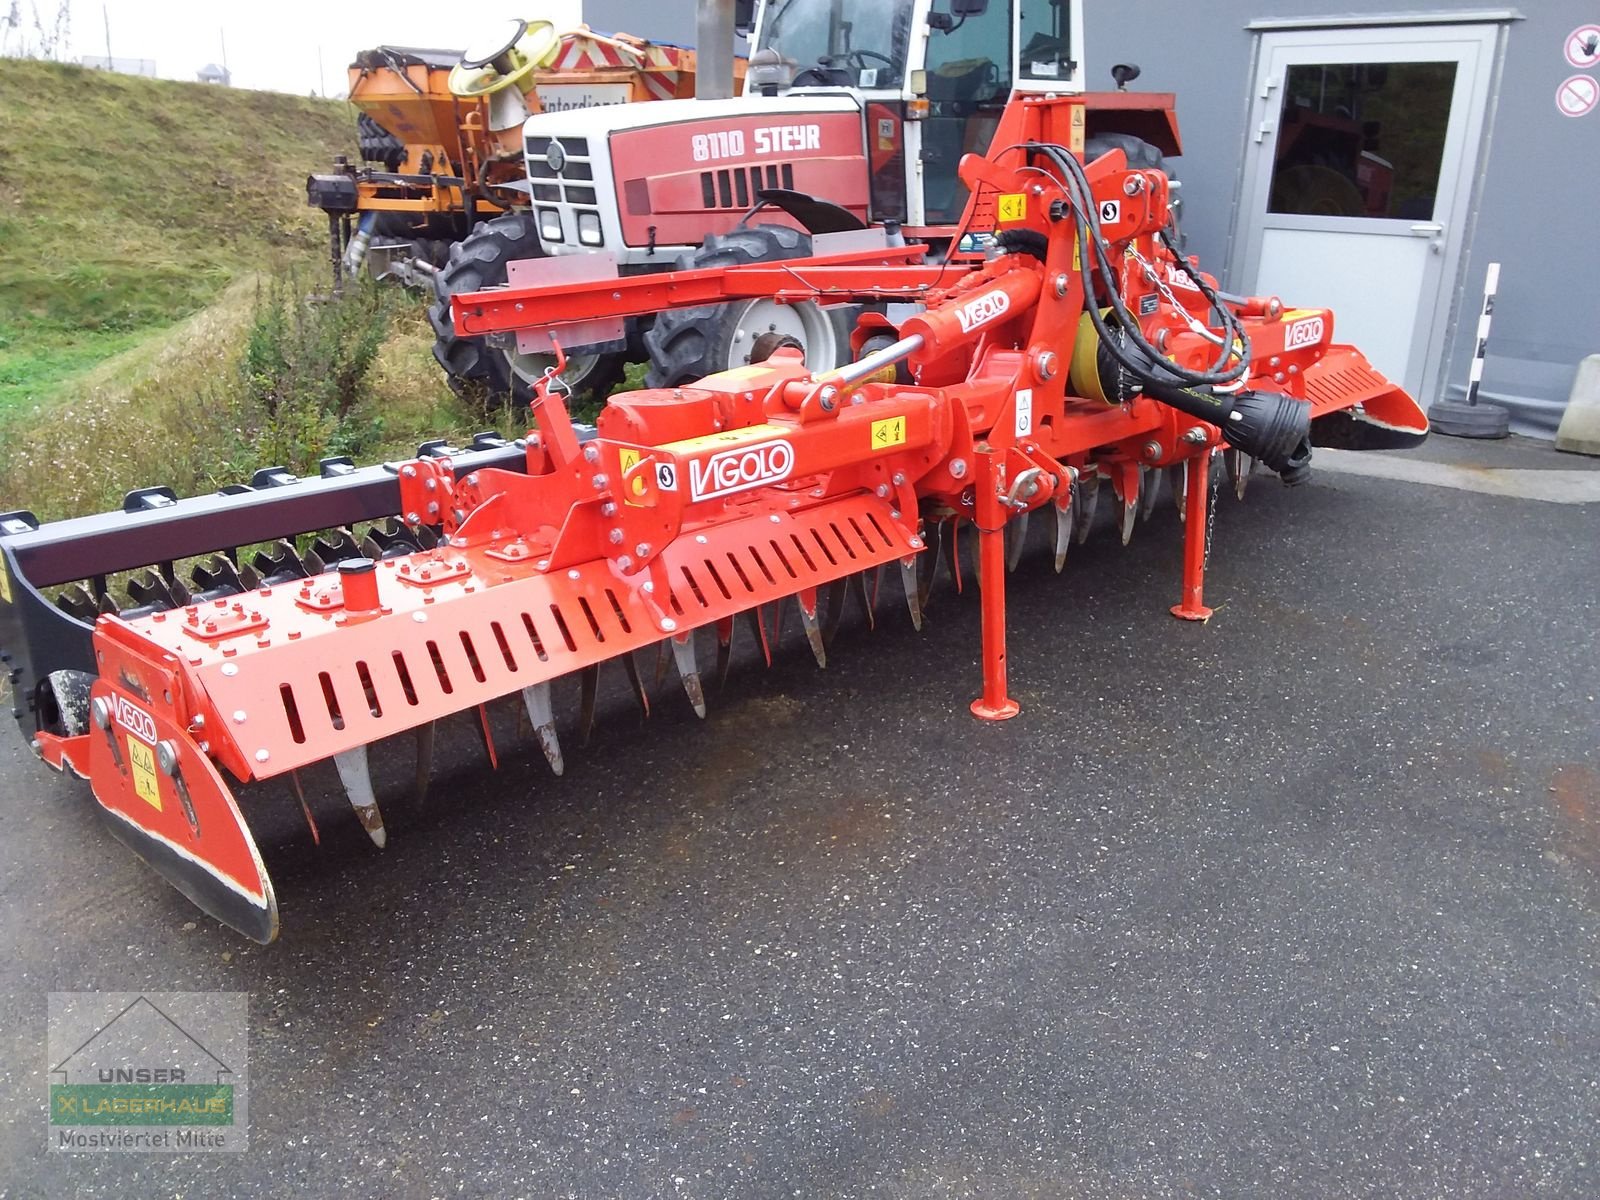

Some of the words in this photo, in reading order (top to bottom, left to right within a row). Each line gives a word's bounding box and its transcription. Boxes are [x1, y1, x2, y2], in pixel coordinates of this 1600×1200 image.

[691, 130, 745, 162] 8110
[754, 124, 821, 154] STEYR
[954, 289, 1010, 334] VIGOLO
[1284, 316, 1324, 352] VIGOLO
[688, 438, 795, 503] VIGOLO
[111, 691, 158, 746] VIGOLO
